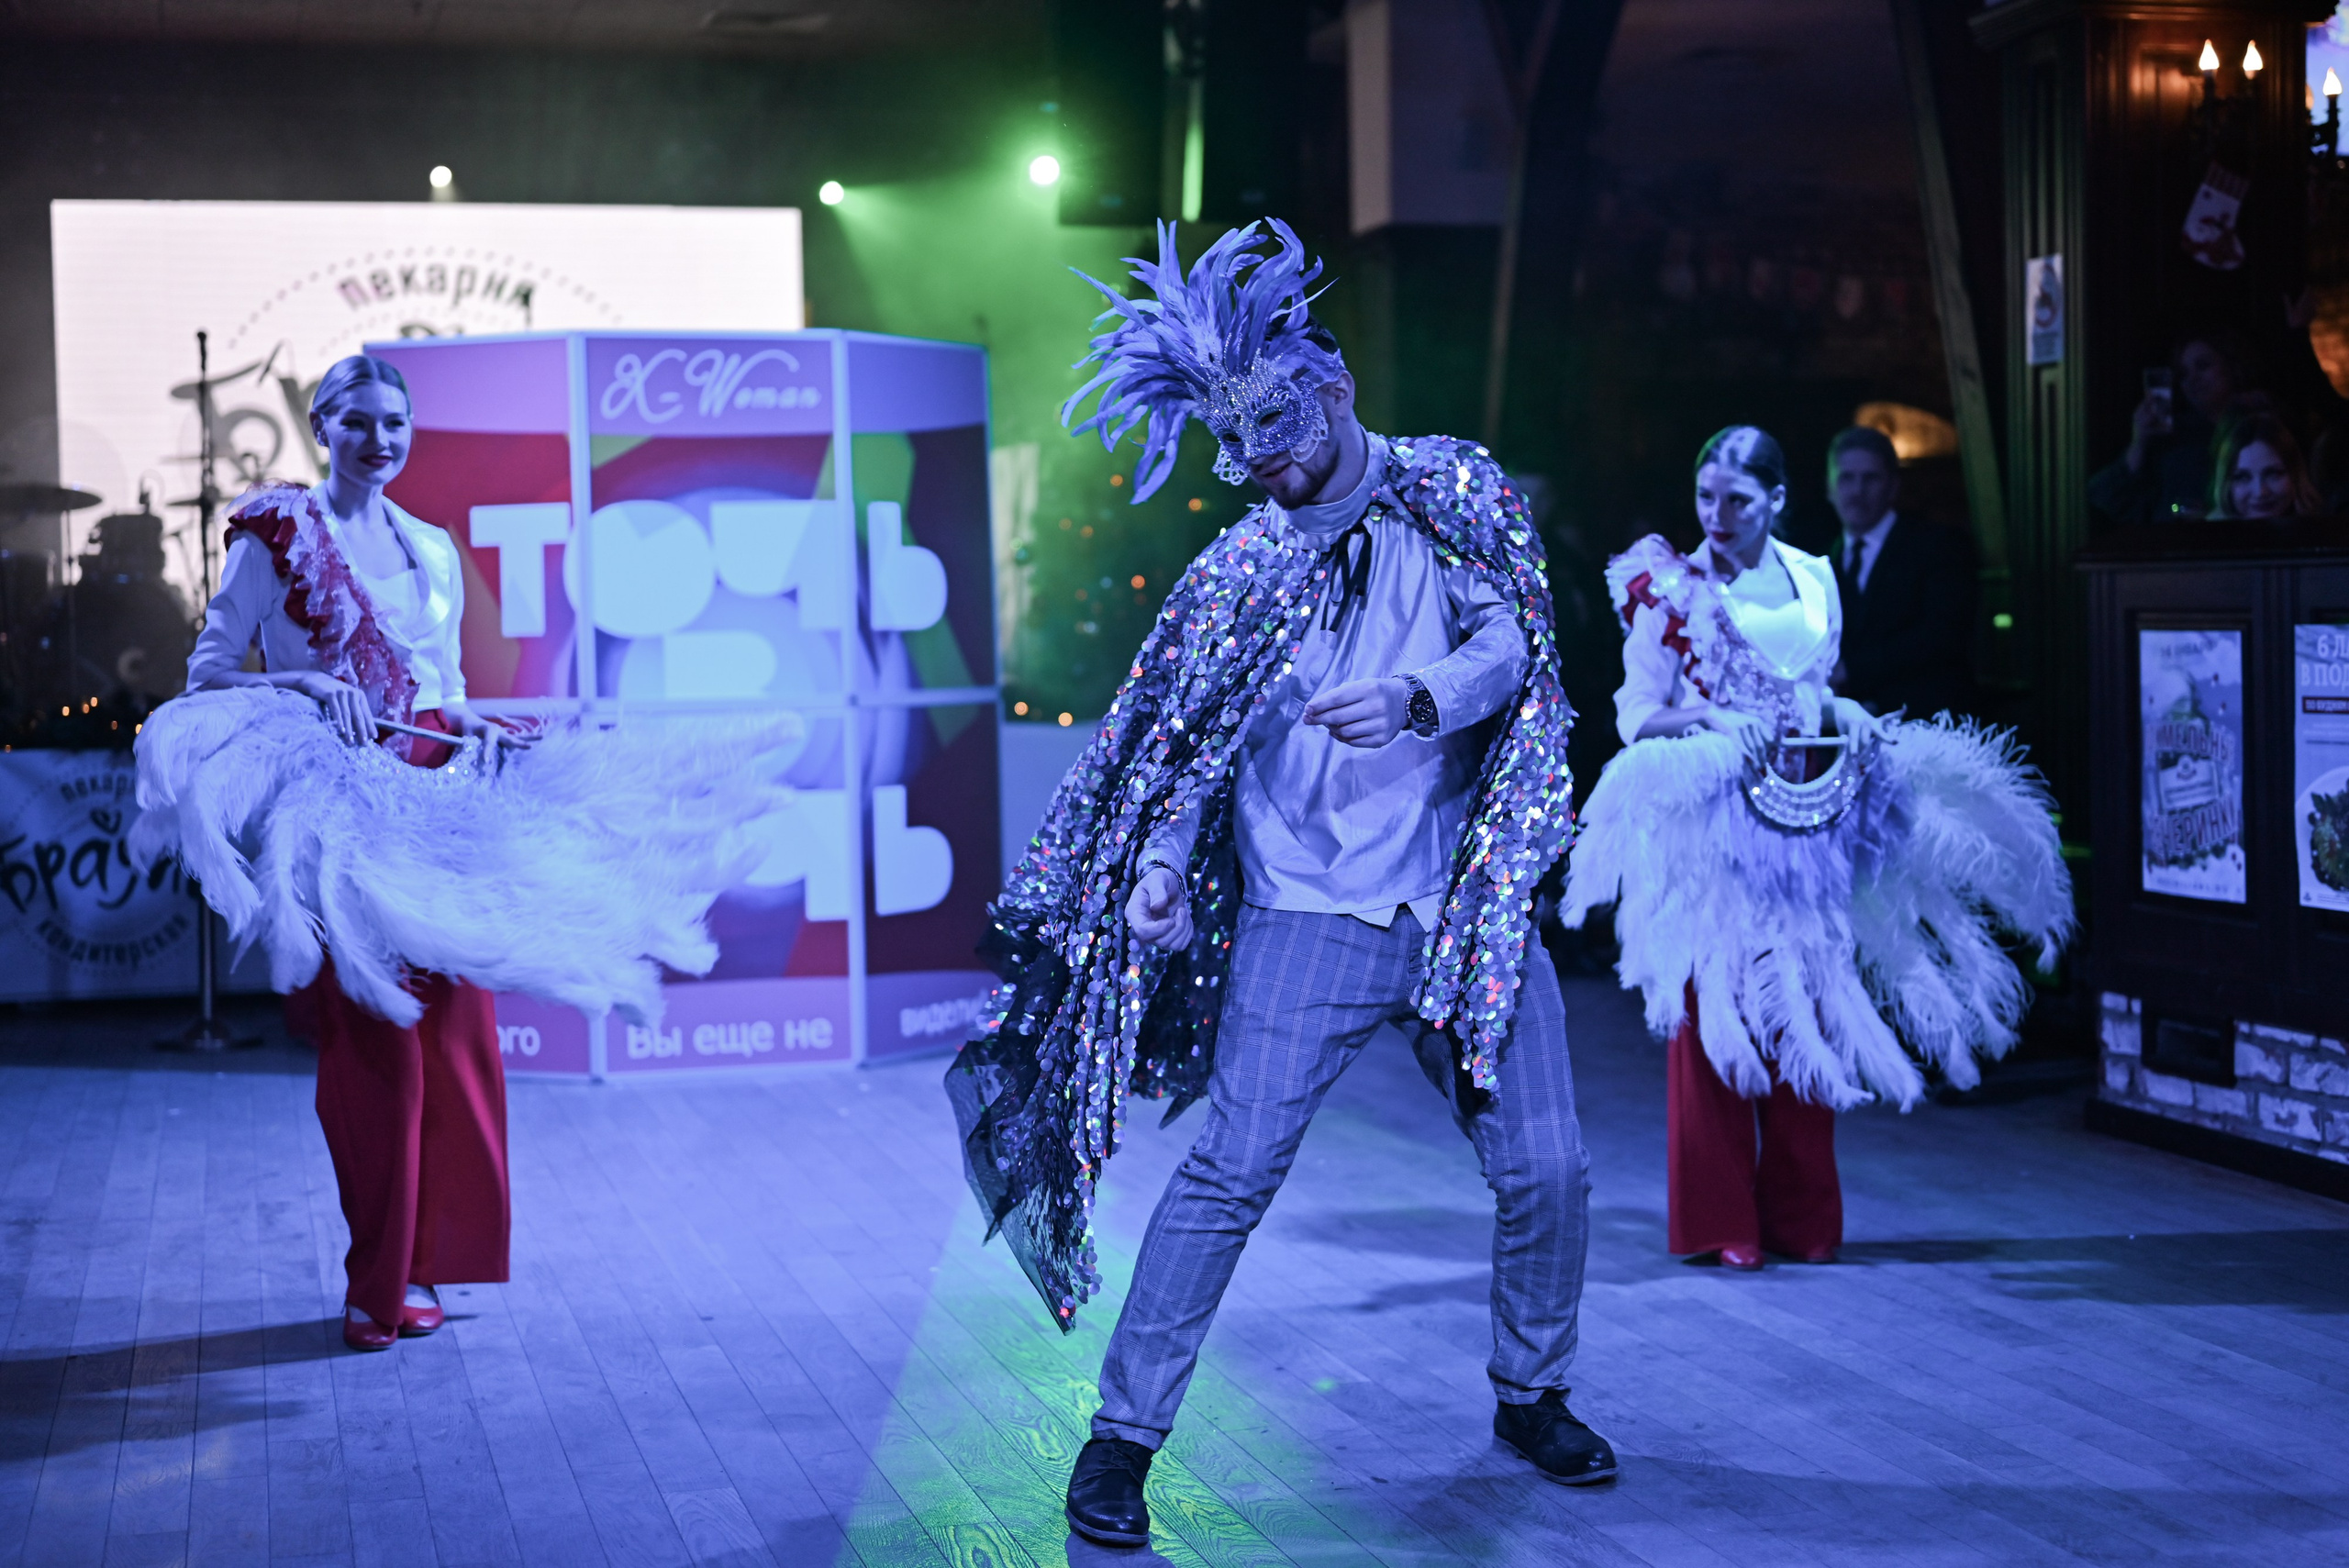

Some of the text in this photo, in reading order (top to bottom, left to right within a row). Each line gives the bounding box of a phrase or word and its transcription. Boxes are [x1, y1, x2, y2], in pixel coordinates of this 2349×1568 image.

[61, 773, 135, 801] пекар
[693, 1020, 774, 1058] еще
[783, 1017, 833, 1051] не
